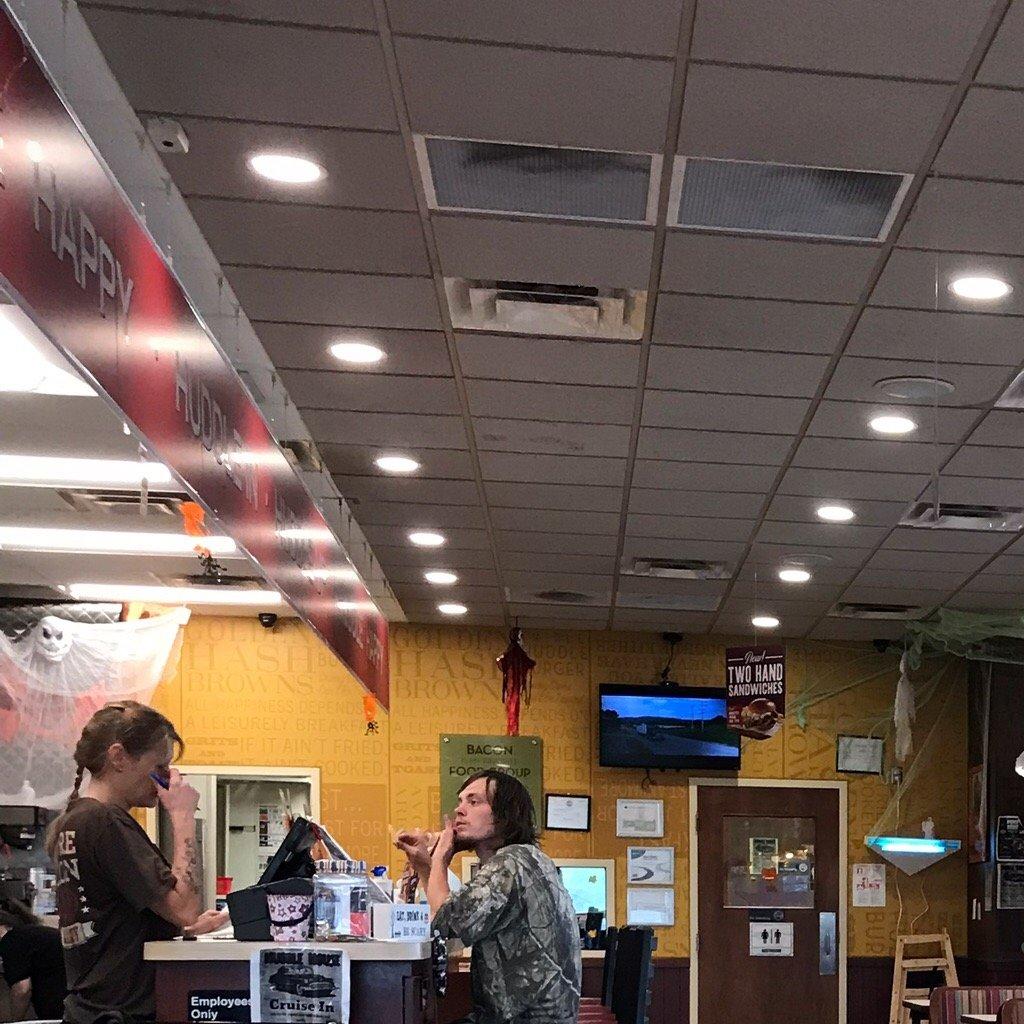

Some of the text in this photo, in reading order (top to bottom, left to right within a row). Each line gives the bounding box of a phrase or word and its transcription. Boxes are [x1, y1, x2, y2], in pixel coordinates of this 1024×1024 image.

[34, 161, 134, 335] HAPPY
[187, 642, 317, 674] HASH
[728, 663, 783, 683] TWO HAND
[187, 673, 314, 695] BROWNS
[395, 679, 502, 700] BROWN
[729, 681, 783, 697] SANDWICHES
[466, 744, 513, 756] BACON
[190, 1009, 218, 1021] Only
[269, 1000, 335, 1013] Cruise In
